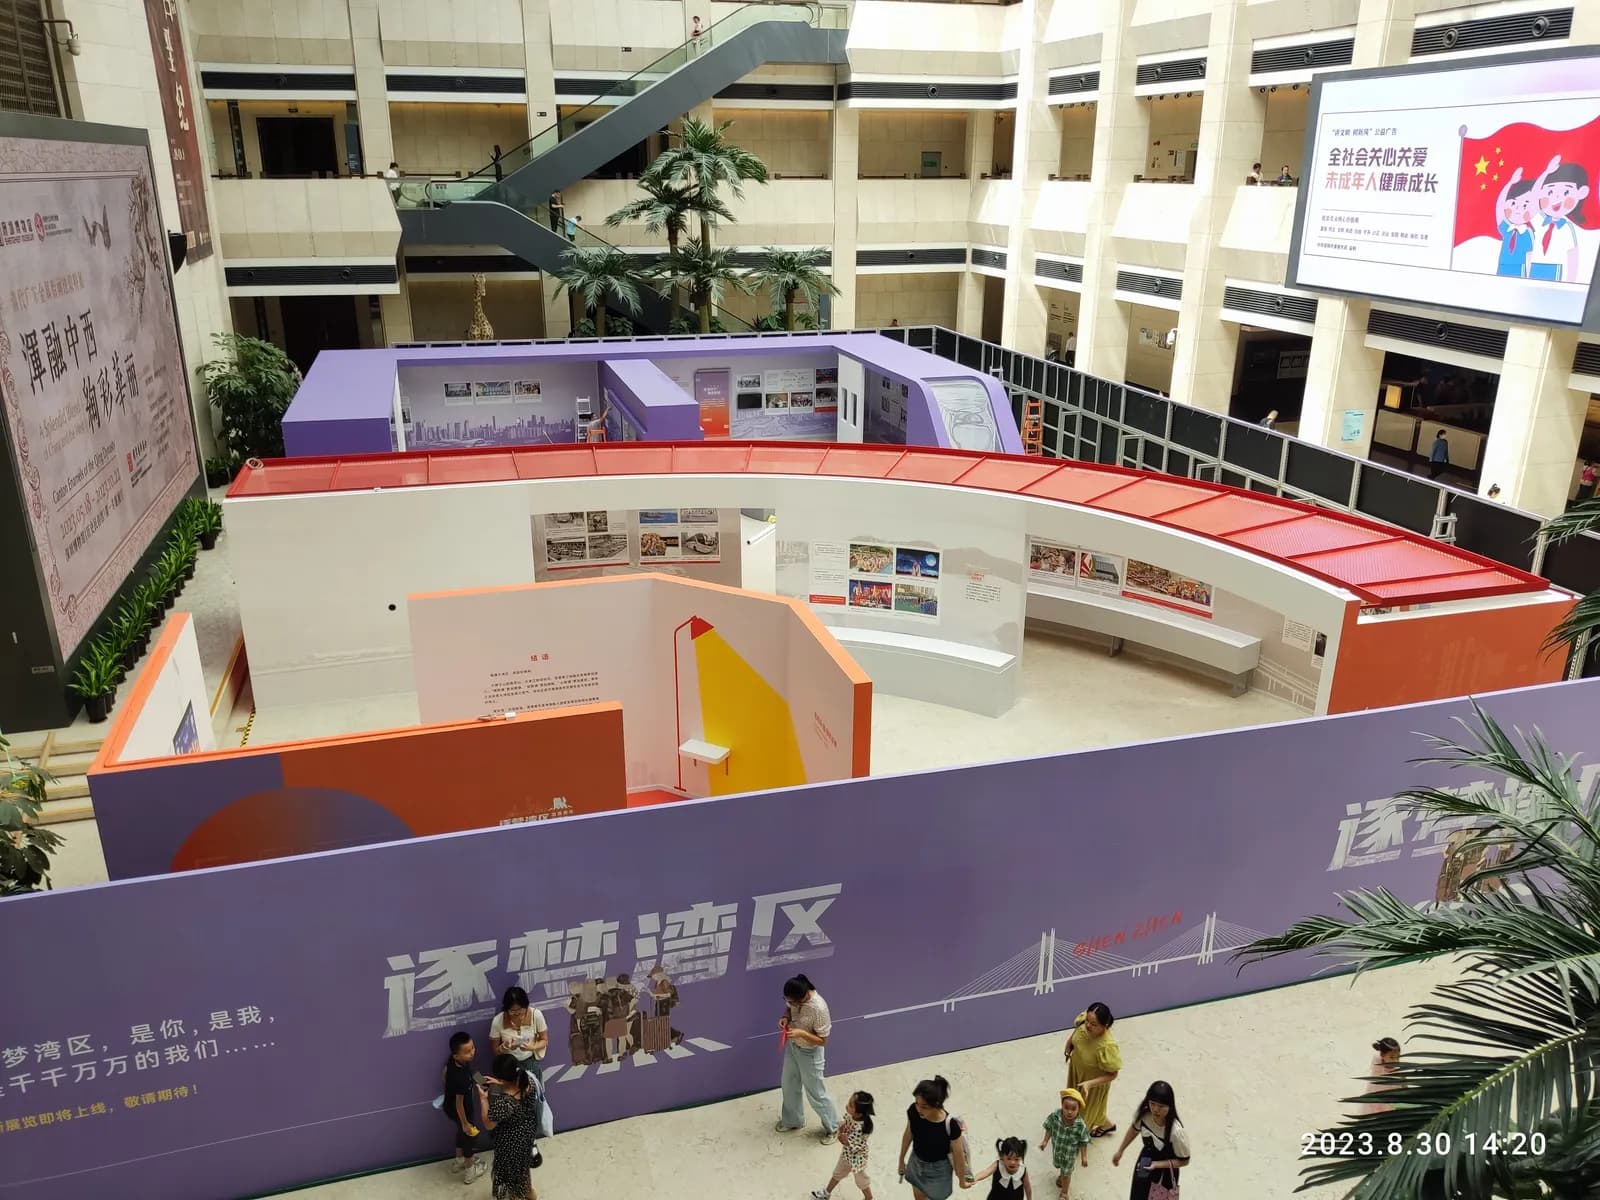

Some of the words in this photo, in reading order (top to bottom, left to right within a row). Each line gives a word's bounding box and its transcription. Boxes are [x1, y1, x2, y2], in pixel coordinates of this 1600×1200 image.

[1328, 147, 1428, 167] 全社会关心关爱
[1325, 171, 1439, 193] 未成年人健康成长
[53, 483, 69, 504] Canton
[382, 883, 842, 1038] 逐梦湾区
